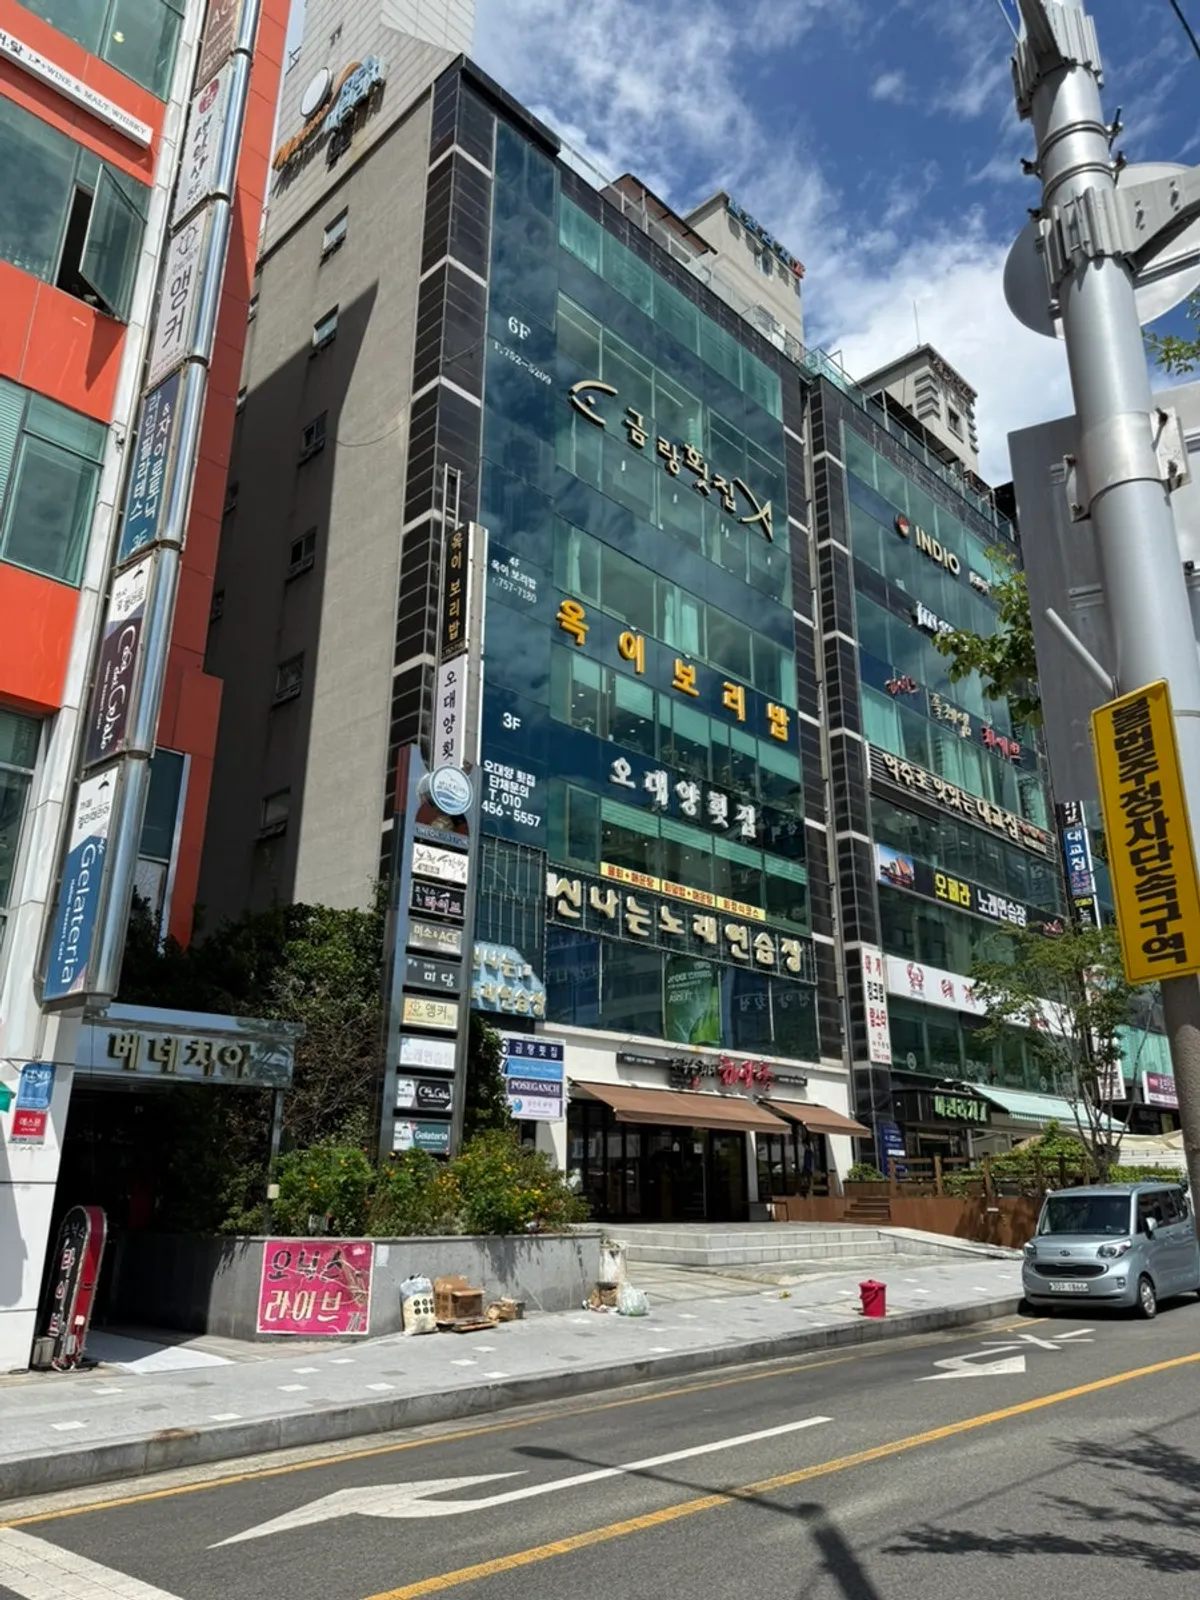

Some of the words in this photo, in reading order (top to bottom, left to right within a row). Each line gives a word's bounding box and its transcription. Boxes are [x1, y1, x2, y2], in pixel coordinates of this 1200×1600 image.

[162, 265, 193, 348] 앵커
[508, 316, 532, 340] 6F
[623, 406, 736, 512] 금랑횟집
[915, 525, 961, 575] INDIO
[556, 599, 790, 742] 옥이보리밥
[442, 670, 458, 760] 오대양횟
[502, 712, 521, 730] 3F
[483, 759, 514, 780] 오대양
[488, 788, 522, 808] T.010
[610, 757, 756, 838] 오대양횟집
[1111, 696, 1187, 964] 불법주정차단속구역
[61, 844, 96, 983] Gelateria
[935, 872, 971, 907] 오페라
[978, 889, 1027, 927] 노래연습장
[425, 1003, 448, 1020] 앵커
[471, 984, 546, 1016] 래연습장
[414, 1131, 449, 1141] Gelateria
[264, 1290, 343, 1322] 라이브
